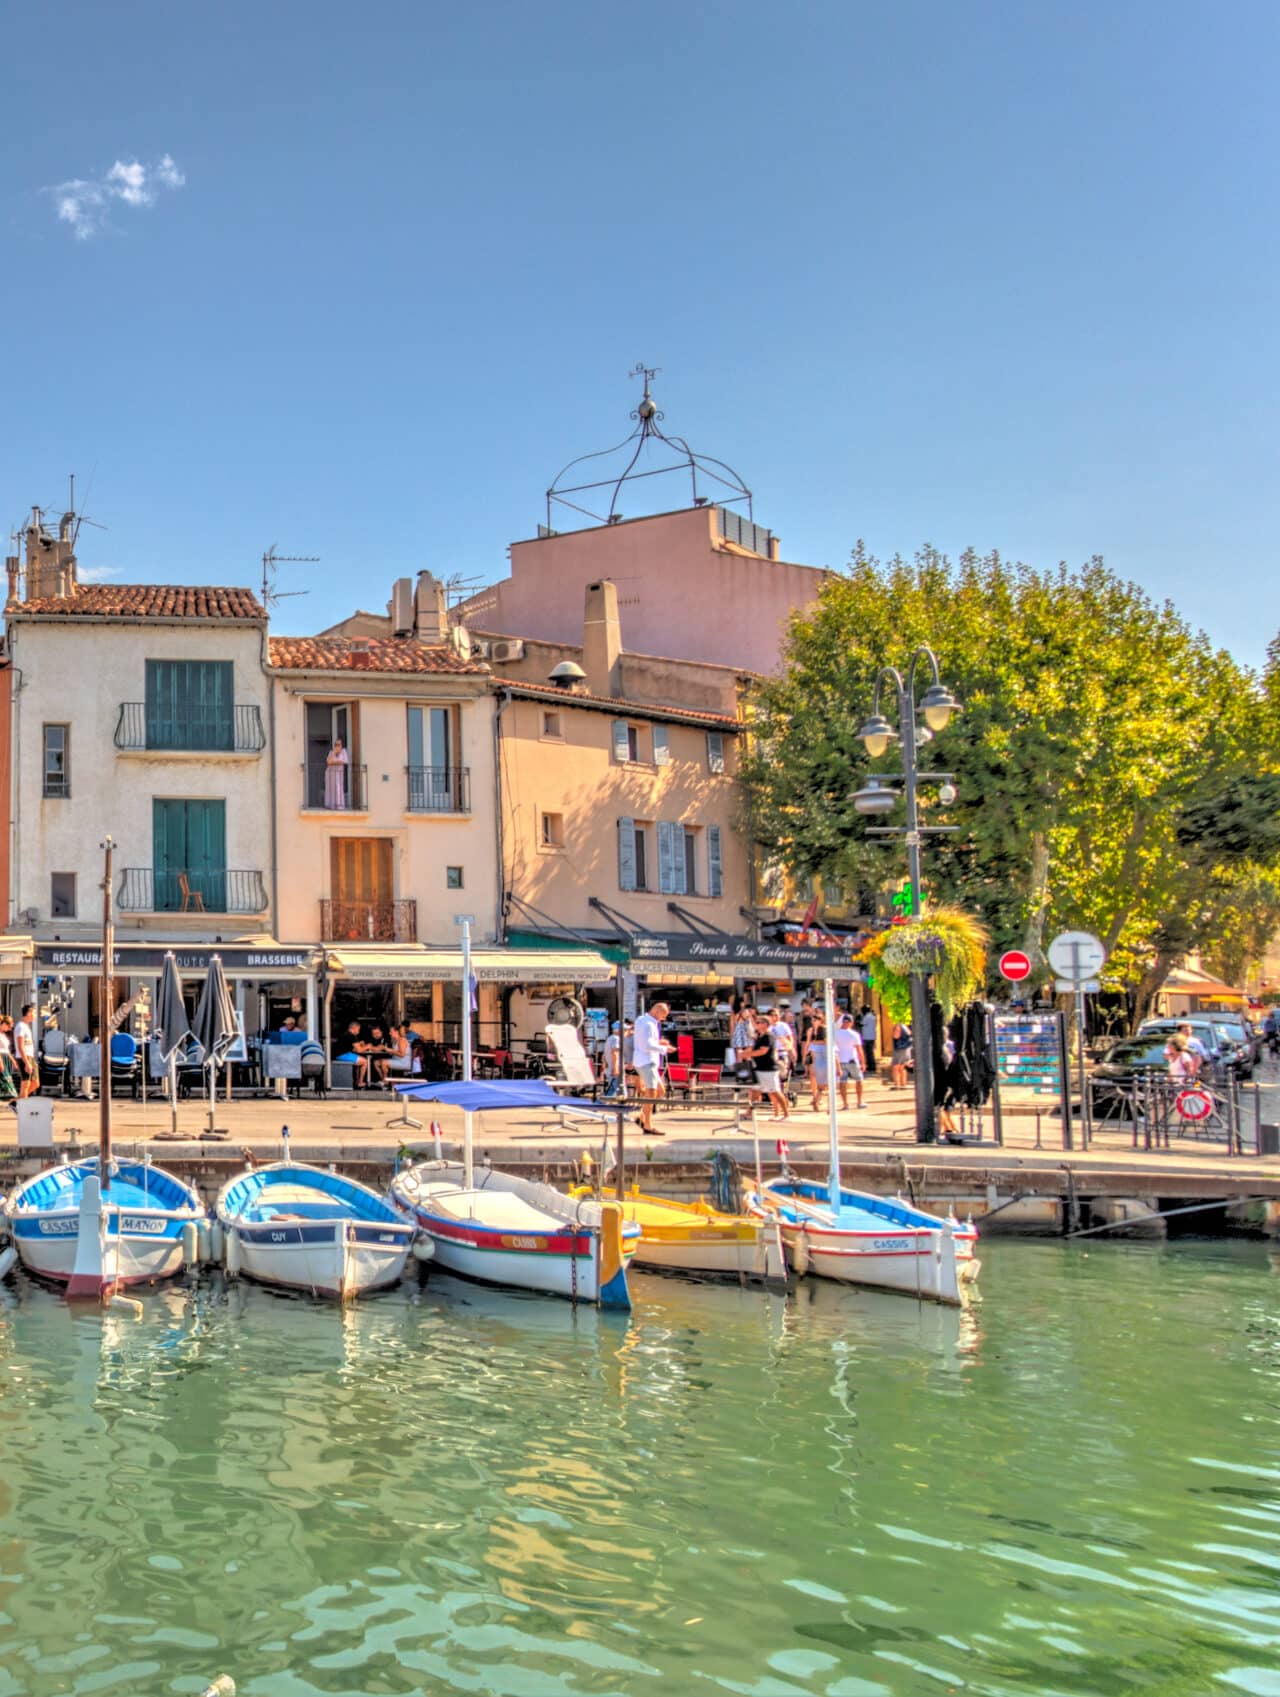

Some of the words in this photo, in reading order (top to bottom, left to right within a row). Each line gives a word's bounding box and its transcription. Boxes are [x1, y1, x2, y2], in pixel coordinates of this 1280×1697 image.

[689, 941, 729, 956] Snack
[734, 943, 755, 957] Les
[758, 944, 818, 962] Calanques
[52, 952, 121, 965] RESTAURAT
[247, 954, 303, 966] BRASSERIE
[479, 969, 520, 979] DELPHIN
[40, 1220, 80, 1233] CASSIS
[121, 1218, 162, 1231] MANON
[873, 1240, 910, 1249] CASSIS
